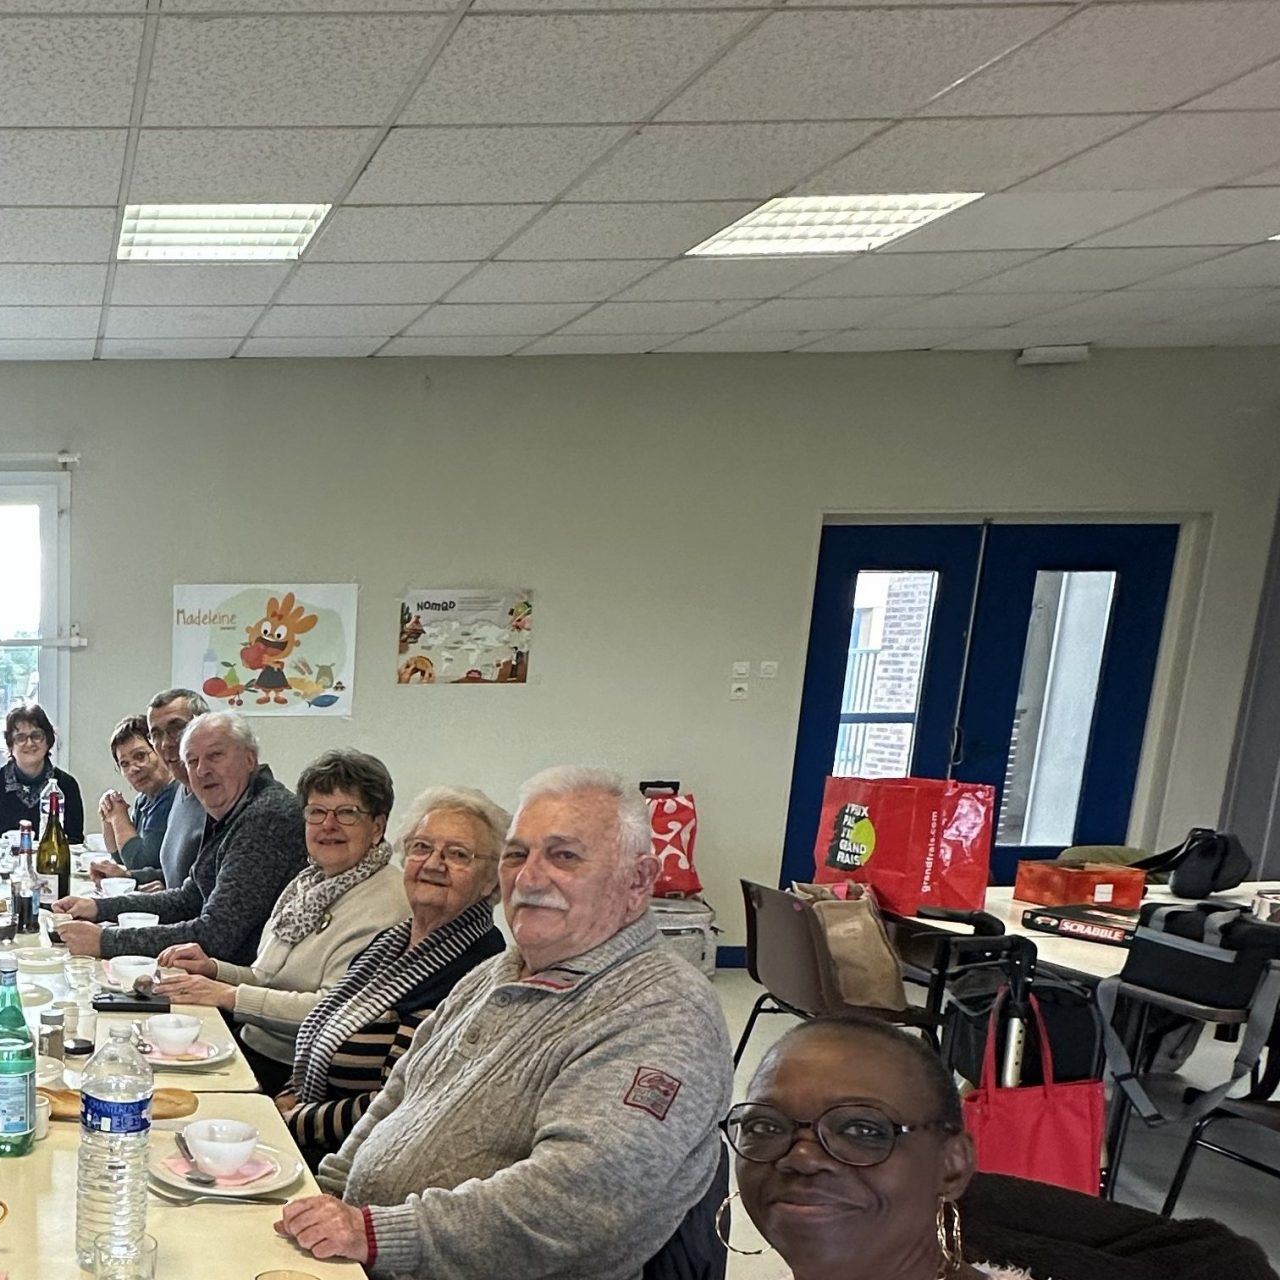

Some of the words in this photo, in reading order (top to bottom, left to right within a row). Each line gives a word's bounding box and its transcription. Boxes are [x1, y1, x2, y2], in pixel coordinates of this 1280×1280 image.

[176, 608, 237, 626] Madeleine
[921, 811, 938, 893] grandfrais.com
[1061, 921, 1122, 941] SCRABBLE
